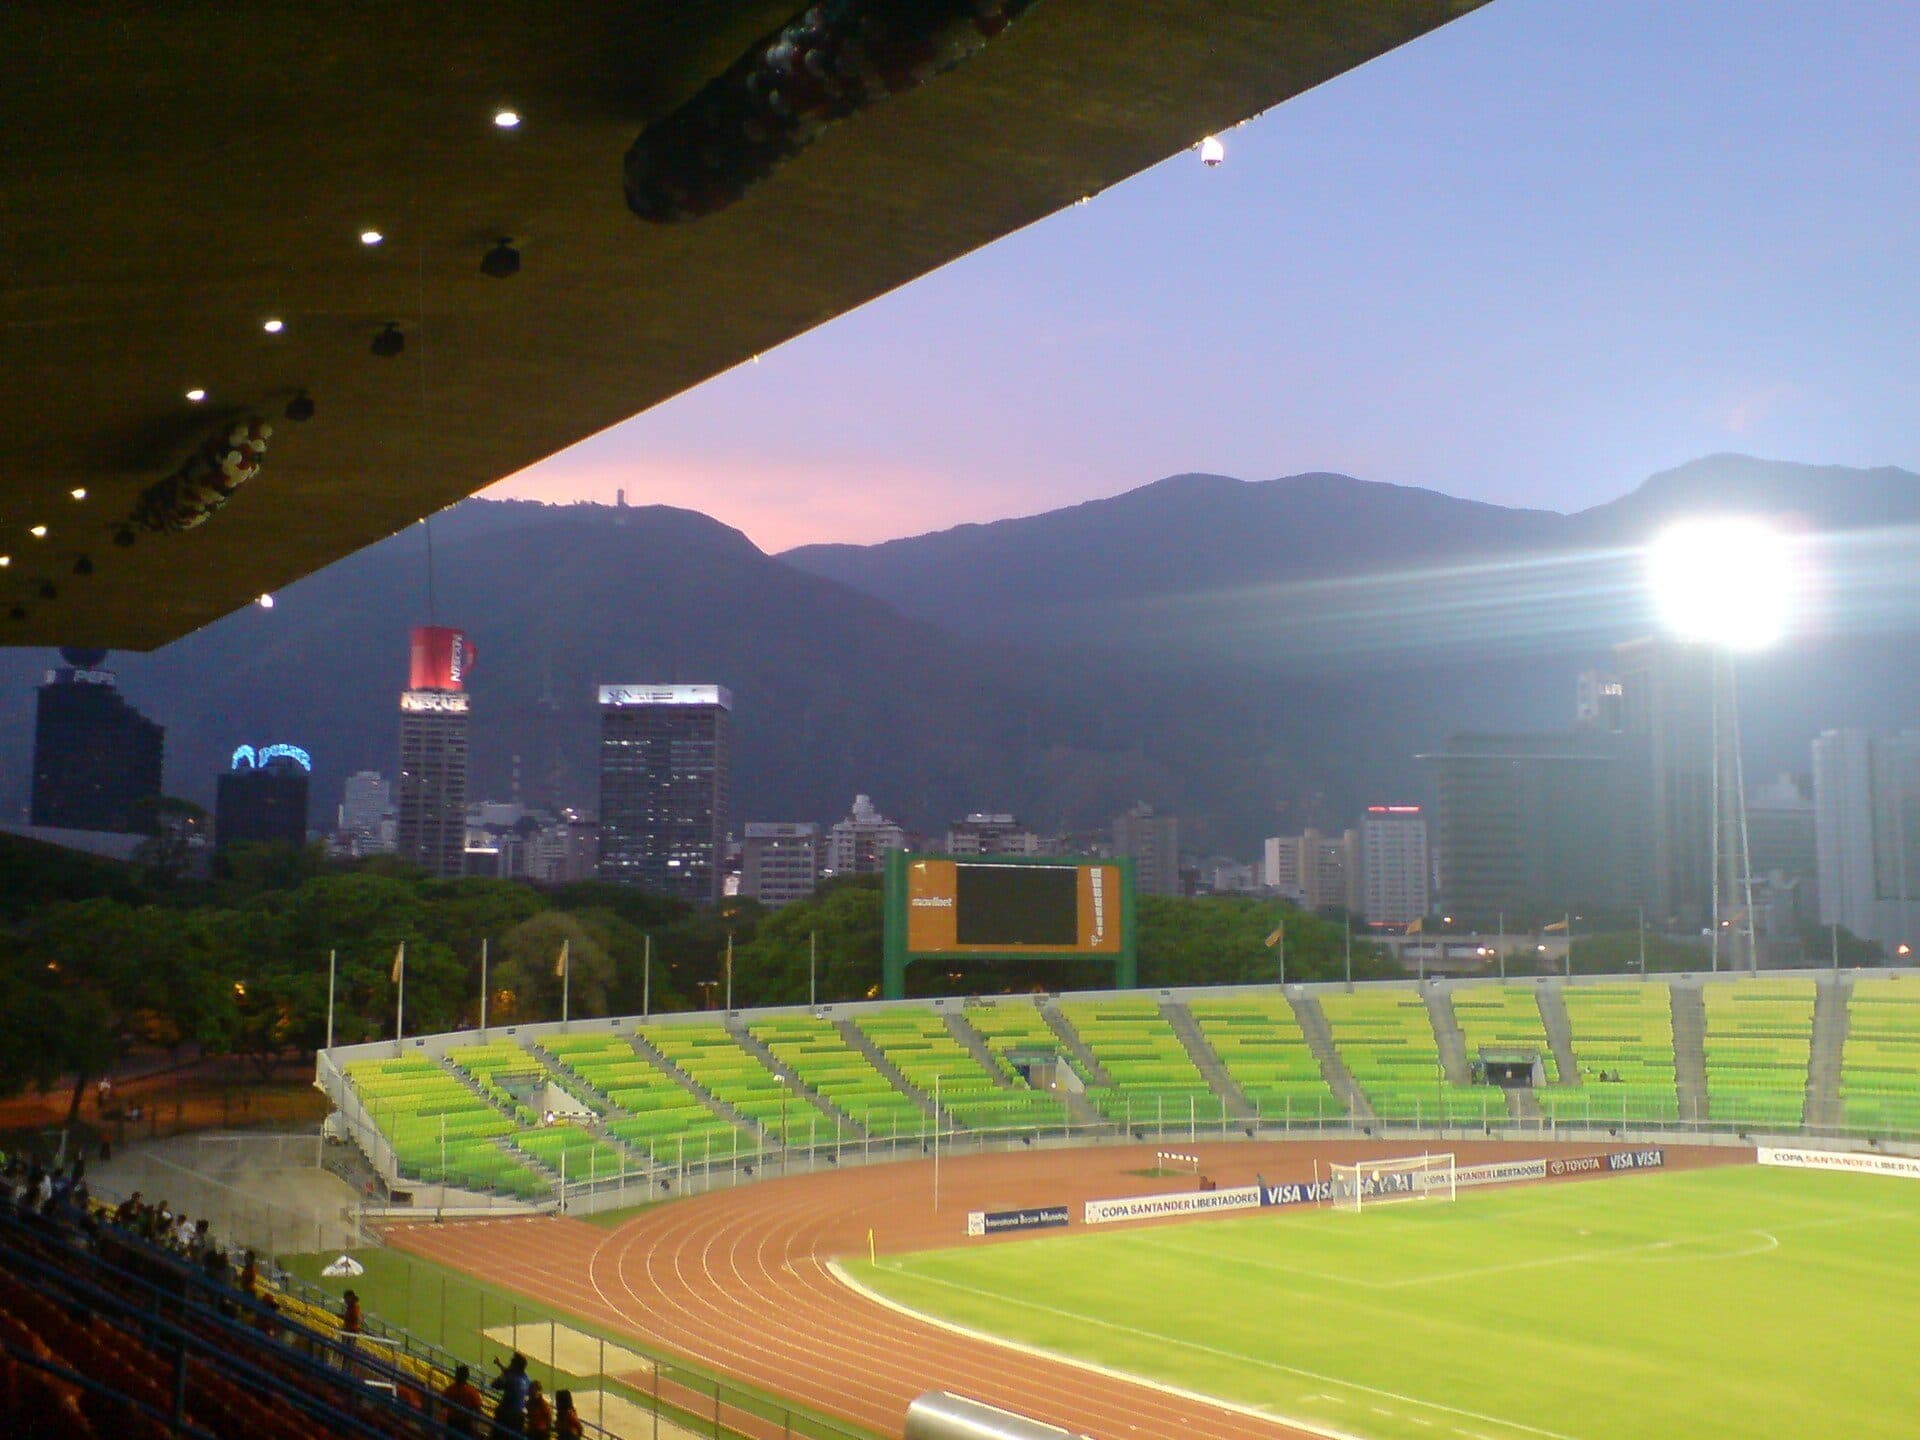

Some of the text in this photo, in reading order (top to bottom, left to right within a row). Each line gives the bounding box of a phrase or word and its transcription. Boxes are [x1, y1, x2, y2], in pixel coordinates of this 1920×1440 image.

[1566, 1158, 1600, 1171] TOYOTA
[1610, 1150, 1661, 1169] VISA VISA
[1774, 1153, 1804, 1163] COPA
[1805, 1155, 1872, 1167] SANTANDER
[1268, 1184, 1301, 1205] VISA
[1102, 1192, 1258, 1218] COPA SANTANDER LIBERTADORES
